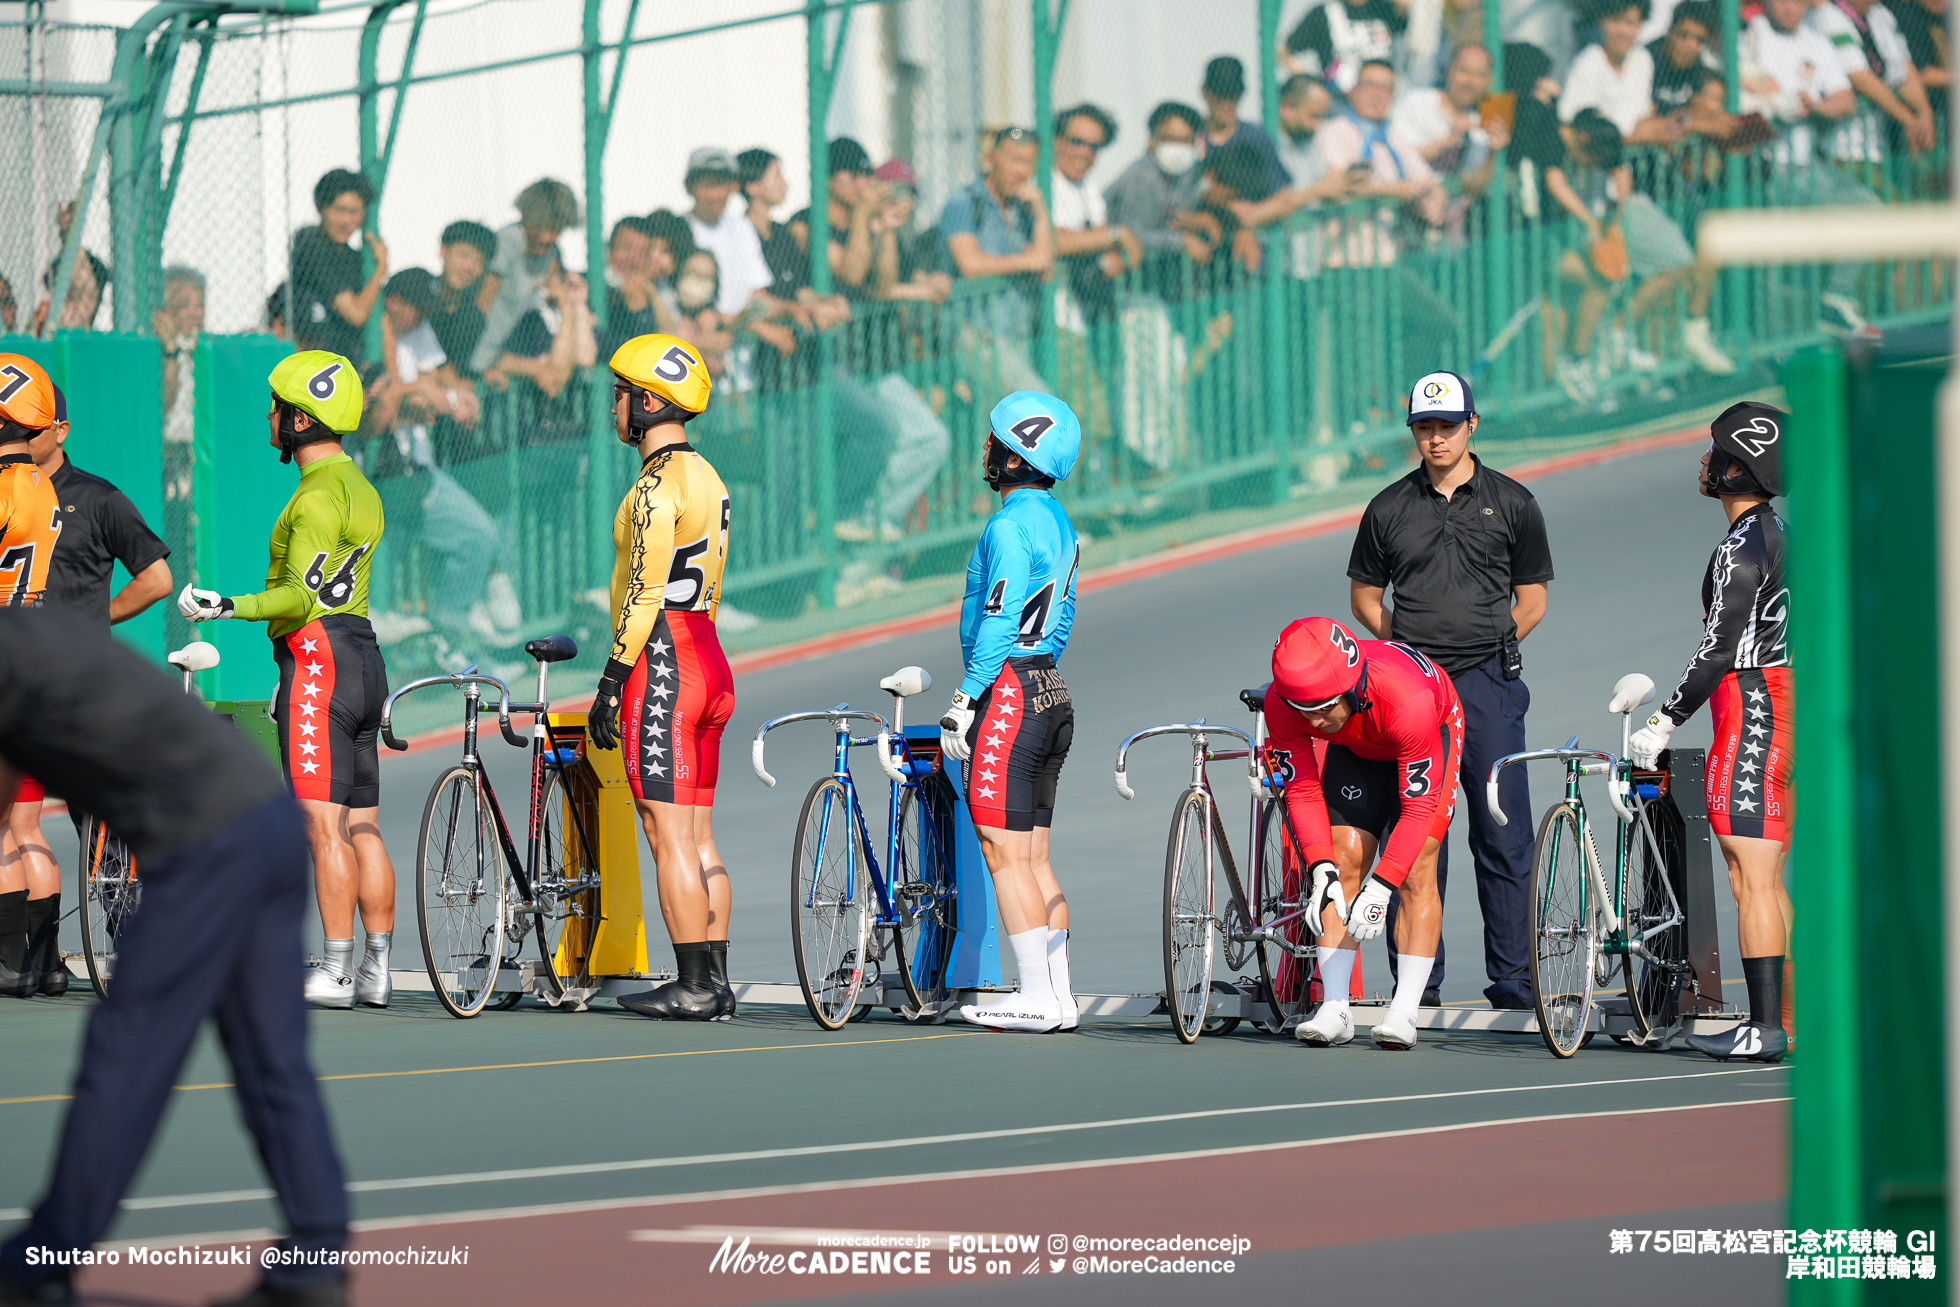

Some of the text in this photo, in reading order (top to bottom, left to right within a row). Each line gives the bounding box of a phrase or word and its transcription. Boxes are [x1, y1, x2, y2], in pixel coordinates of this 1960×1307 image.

[0, 363, 33, 405] 7
[307, 362, 343, 401] 6
[651, 344, 700, 384] 5
[1008, 414, 1057, 451] 4
[1731, 417, 1779, 457] 2
[0, 542, 36, 607] 7
[304, 551, 329, 592] 6
[317, 541, 371, 610] 6
[660, 533, 711, 611] 5
[983, 578, 1008, 615] 4
[1016, 578, 1057, 650] 4
[1330, 623, 1359, 667] 3
[1754, 587, 1791, 667] 2
[1273, 749, 1295, 782] 3
[1722, 761, 1731, 775] KING
[1724, 752, 1732, 761] OF
[1403, 757, 1432, 799] 3
